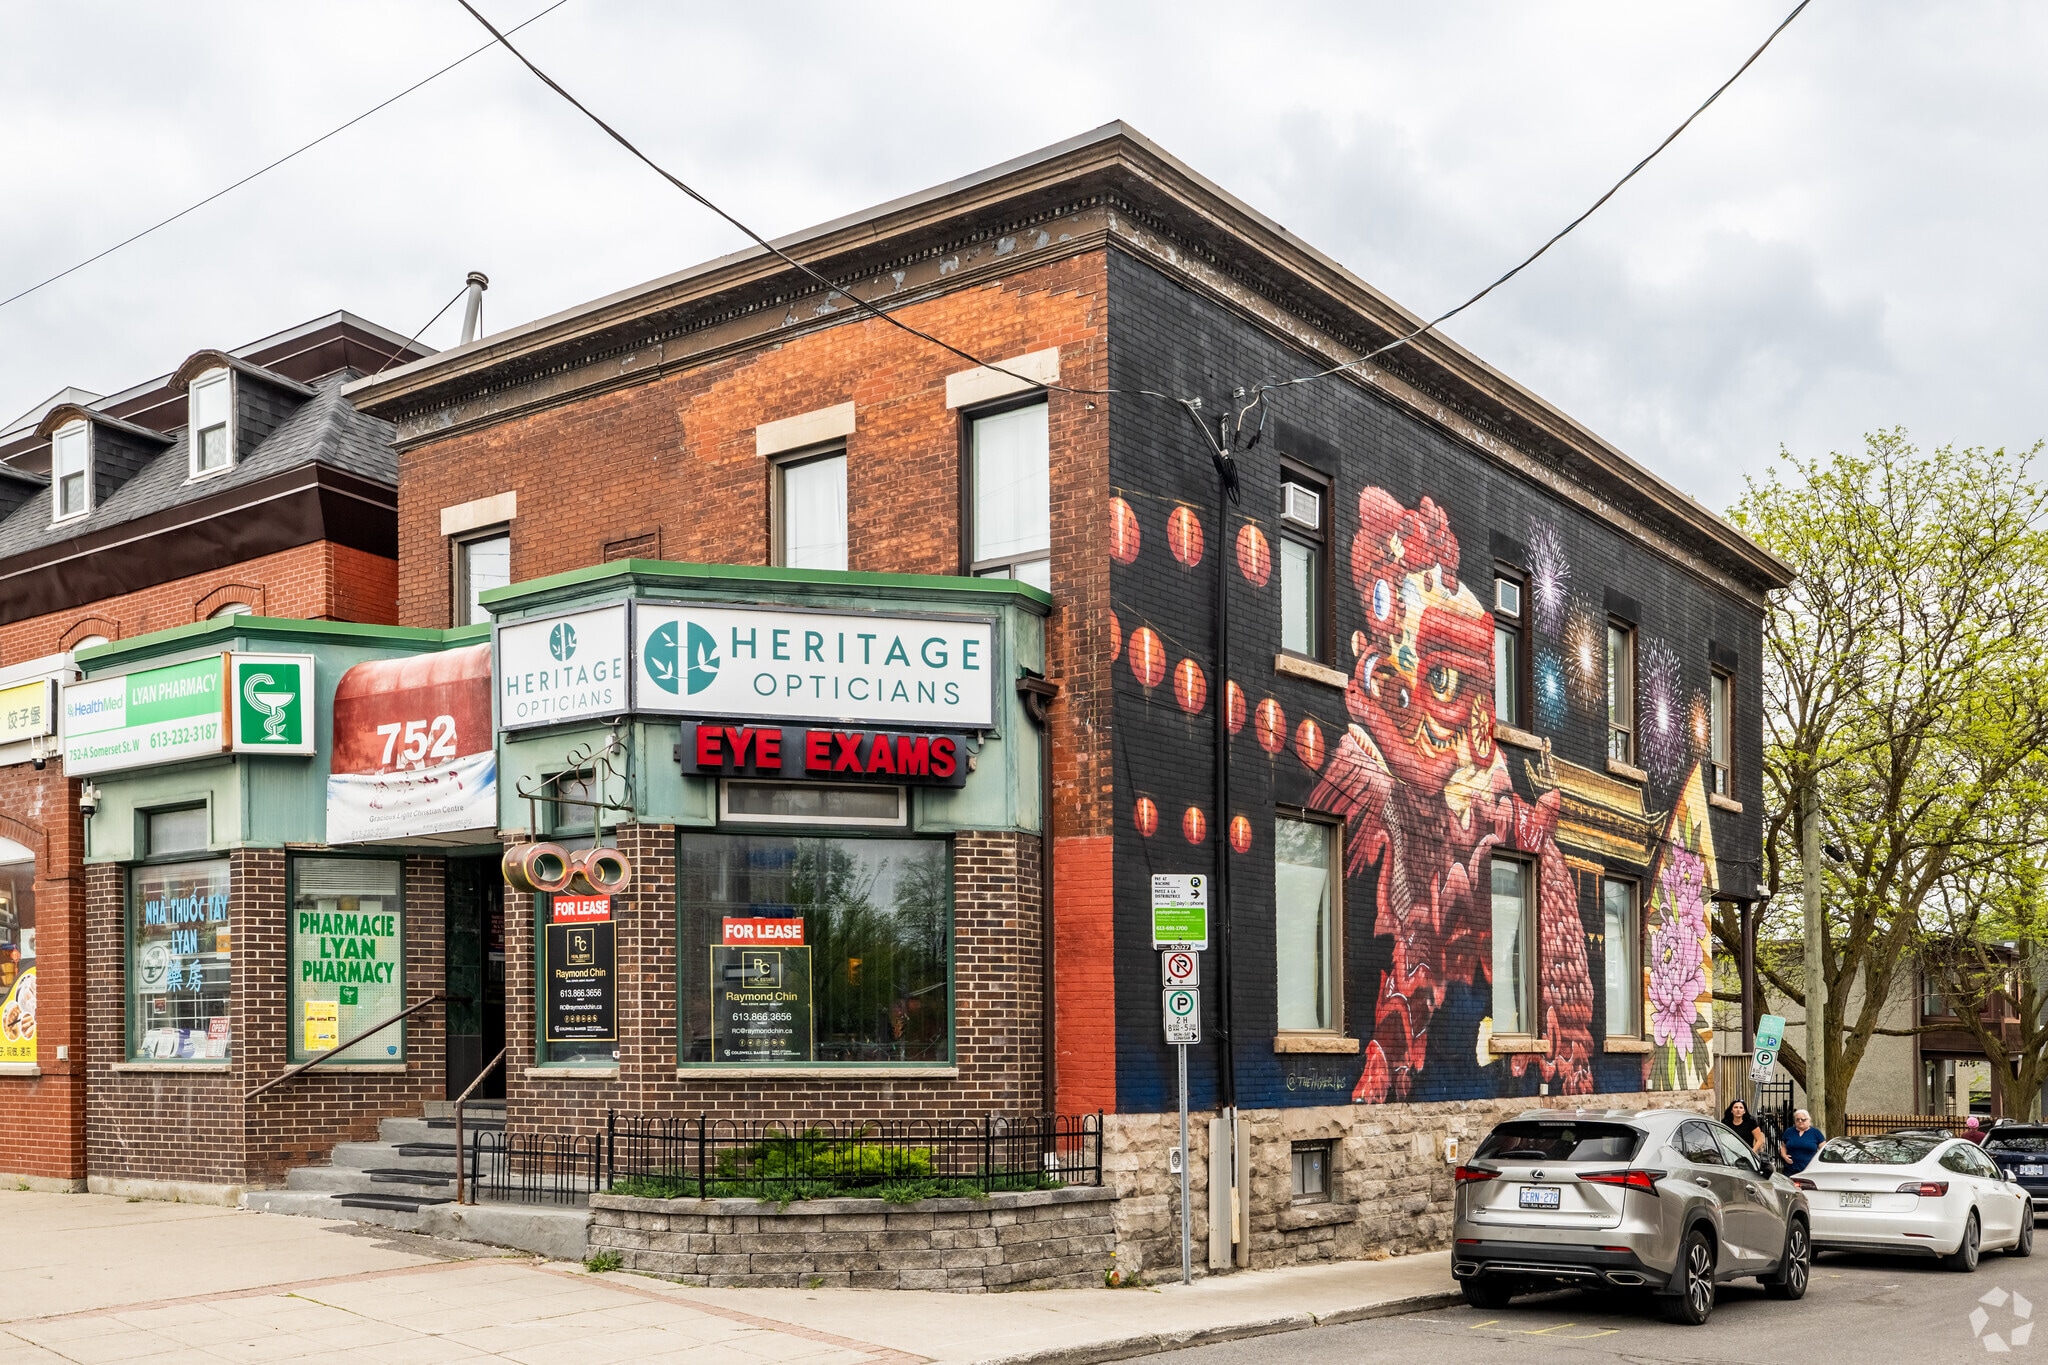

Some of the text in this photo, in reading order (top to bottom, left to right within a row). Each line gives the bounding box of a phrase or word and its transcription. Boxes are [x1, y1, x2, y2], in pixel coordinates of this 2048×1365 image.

[731, 626, 981, 671] HERITAGE
[506, 656, 623, 697] HERITAGE
[753, 672, 960, 705] OPTICIANS
[132, 672, 217, 706] LYAN PHARMACY
[74, 694, 123, 716] HealthMed
[516, 688, 613, 718] OPTICIANS
[150, 722, 218, 749] 613-232-3187
[377, 714, 457, 765] 752
[69, 738, 140, 762] 752-A Somerset St. W
[696, 723, 957, 778] EYE EXAMS
[369, 804, 464, 823] Gracious Light Christian Centre
[145, 896, 167, 925] NHÀ
[207, 894, 228, 921] TÂY
[555, 900, 608, 916] FOR LEASE
[300, 913, 395, 937] PHARMACIE
[725, 924, 801, 939] FOR LEASE
[172, 929, 198, 955] LYAN
[320, 937, 376, 960] LYAN
[302, 960, 394, 984] PHARMACY
[556, 968, 606, 980] Raymond Chin
[560, 988, 602, 998] 613.866.3656
[726, 991, 798, 1003] Raymond Chin
[732, 1012, 792, 1021] 613.866.3656
[1543, 1192, 1558, 1203] 278
